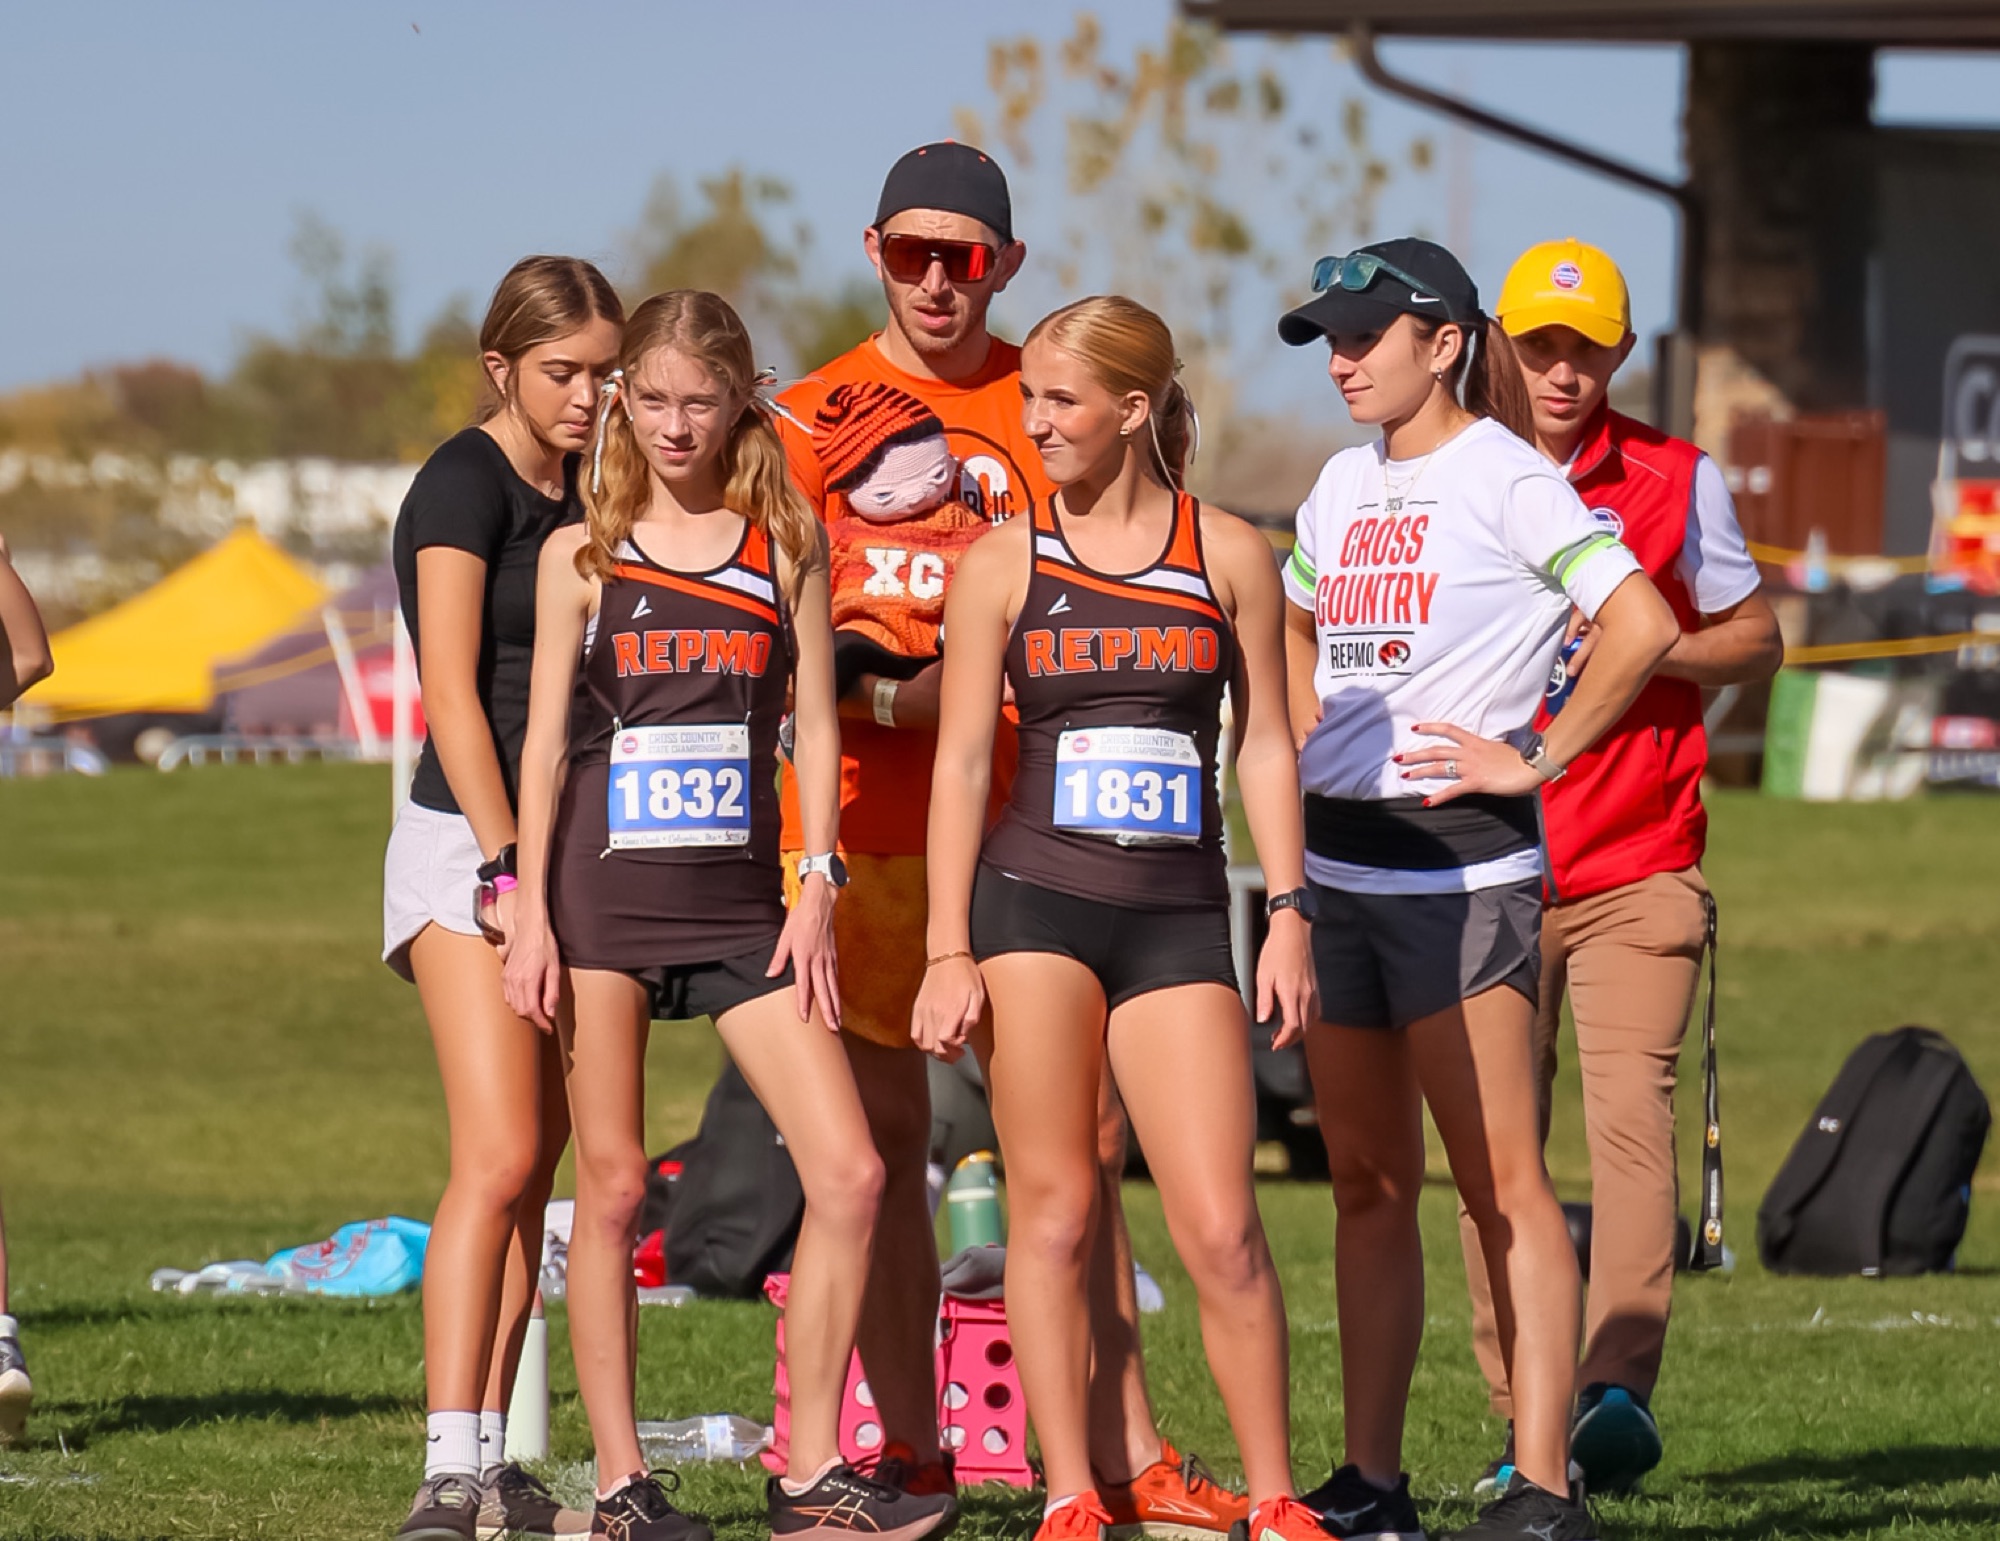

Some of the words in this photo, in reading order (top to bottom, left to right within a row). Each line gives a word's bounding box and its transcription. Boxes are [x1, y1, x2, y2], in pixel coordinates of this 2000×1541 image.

[1340, 514, 1429, 568] CROSS
[863, 547, 945, 599] XC
[1315, 572, 1440, 627] COUNTRY
[612, 629, 772, 677] REPMO
[1023, 626, 1219, 677] REPMO
[1330, 641, 1374, 669] REPMO
[680, 731, 722, 744] COUNTRY
[1133, 734, 1175, 748] COUNTRY
[616, 768, 743, 820] 1832
[1064, 768, 1188, 824] 1831
